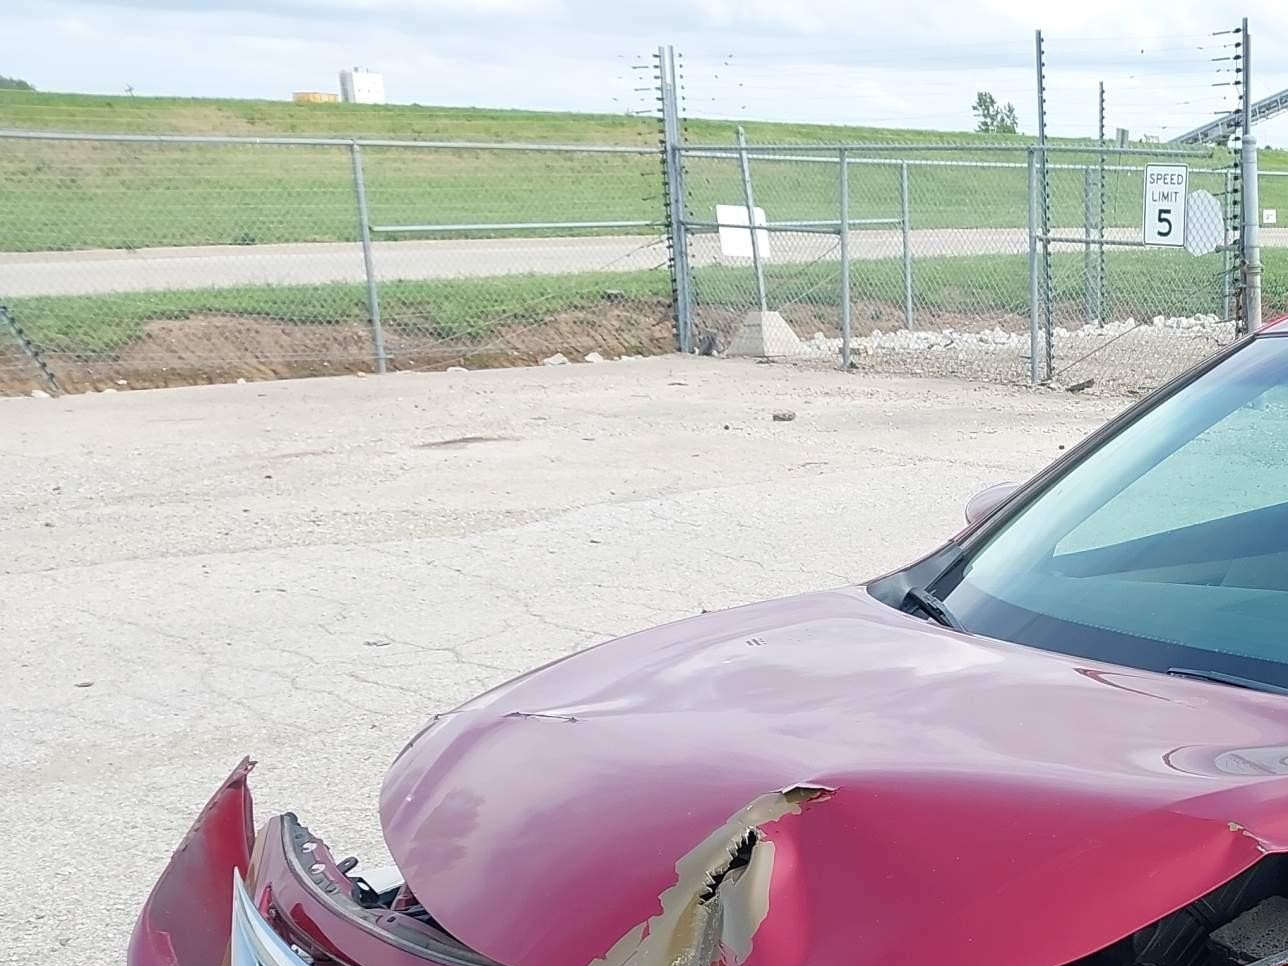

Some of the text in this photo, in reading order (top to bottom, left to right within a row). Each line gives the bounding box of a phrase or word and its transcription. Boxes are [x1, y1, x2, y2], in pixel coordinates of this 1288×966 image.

[1149, 173, 1184, 185] SPEED
[1151, 191, 1180, 203] LIMIT
[1156, 208, 1173, 238] 5
